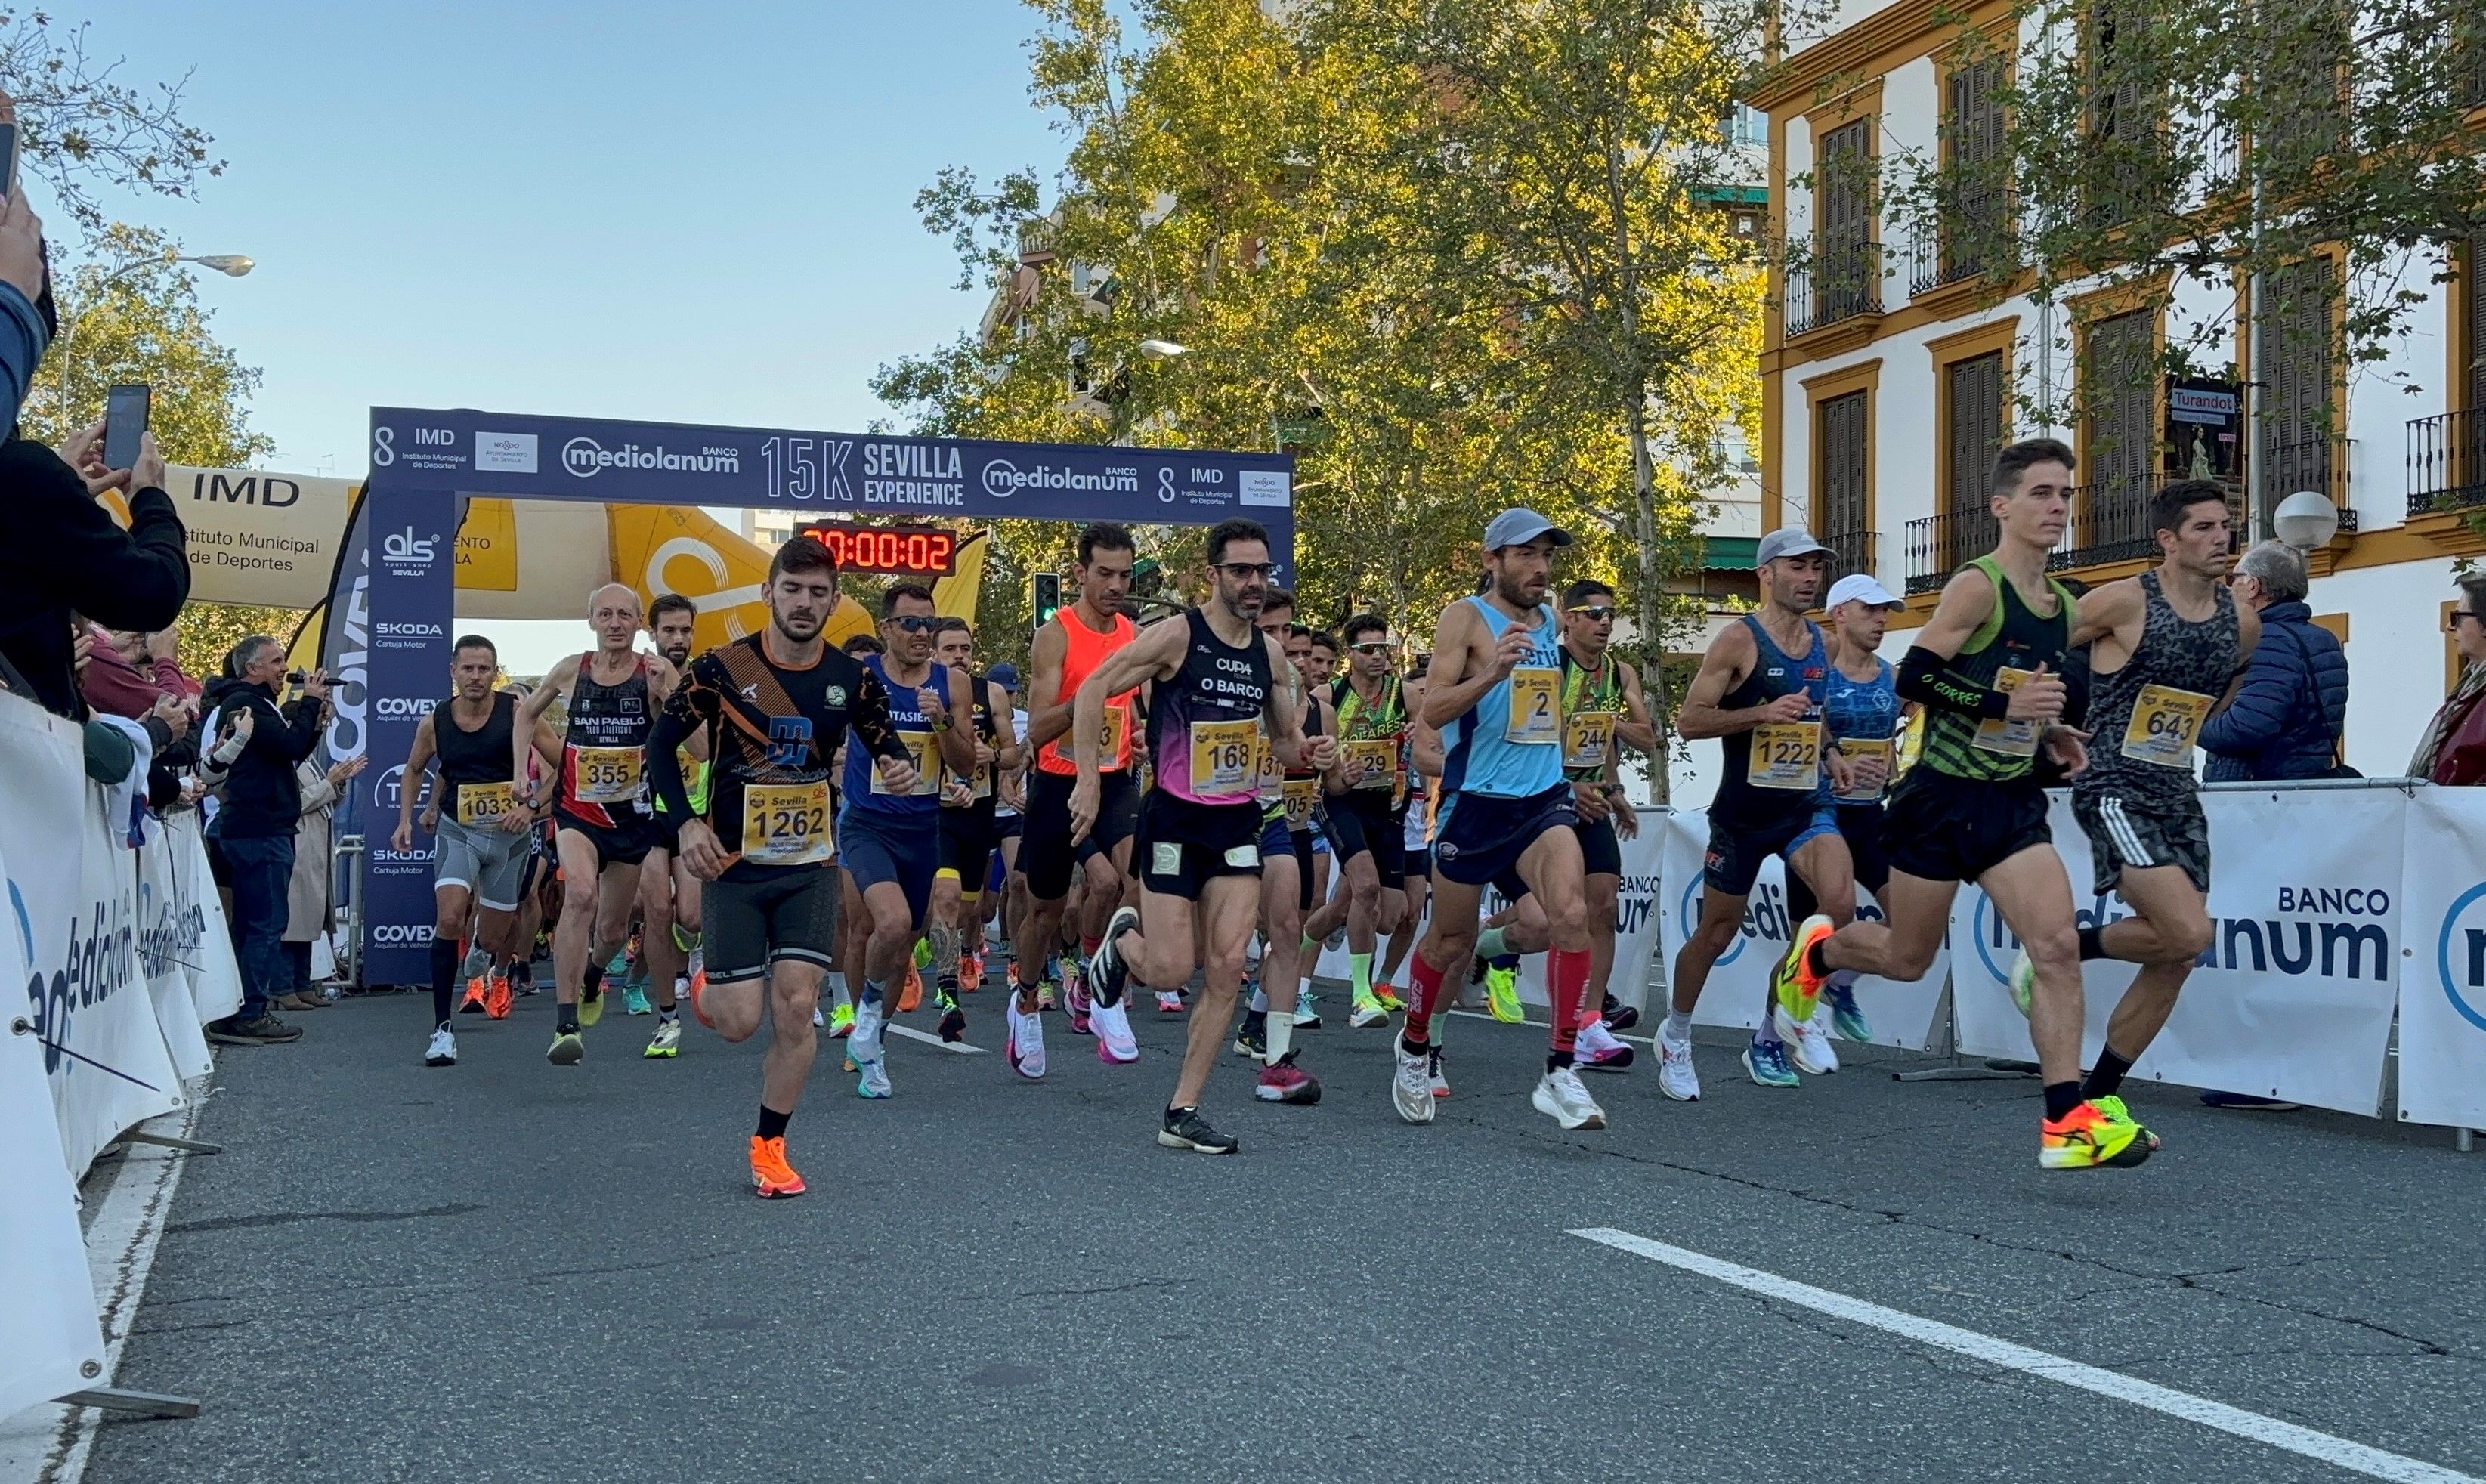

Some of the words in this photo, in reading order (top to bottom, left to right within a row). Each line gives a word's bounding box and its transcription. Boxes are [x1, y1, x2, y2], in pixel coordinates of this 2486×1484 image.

[2175, 391, 2232, 410] Turandot
[416, 428, 455, 446] IMD
[402, 452, 431, 461] Instituto
[431, 453, 467, 463] Municipal
[570, 444, 739, 474] mediolanum
[703, 446, 738, 457] BANCO
[864, 444, 963, 479] SEVILLA
[413, 460, 422, 468] de
[424, 462, 456, 470] Deportes
[762, 437, 854, 501] 15K
[1105, 467, 1137, 477] BANCO
[990, 465, 1138, 493] mediolanum
[1191, 468, 1223, 484] IMD
[193, 473, 300, 508] IMD
[864, 481, 964, 505] EXPERIENCE
[1181, 490, 1205, 498] Instituto
[1198, 497, 1226, 505] Deportes
[239, 532, 319, 555] Municipal
[190, 550, 211, 564] de
[217, 552, 293, 572] Deportes
[376, 639, 402, 649] Cartuja
[1215, 657, 1253, 675] CUPA
[1201, 677, 1214, 691] O
[1217, 679, 1263, 700] BARCO
[1933, 682, 1984, 707] CORRES
[1535, 691, 1548, 716] 2
[574, 717, 599, 725] SAN
[601, 716, 645, 725] PABLO
[2147, 710, 2195, 740] 643
[1577, 729, 1607, 748] 244
[1207, 743, 1249, 770] 168
[1758, 740, 1816, 765] 1222
[586, 764, 629, 784] 355
[463, 797, 512, 817] 1033
[771, 796, 808, 806] Sevilla
[753, 807, 824, 838] 1262
[373, 867, 399, 876] Cartuja
[2279, 886, 2390, 916] BANCO
[373, 925, 437, 942] COVEY
